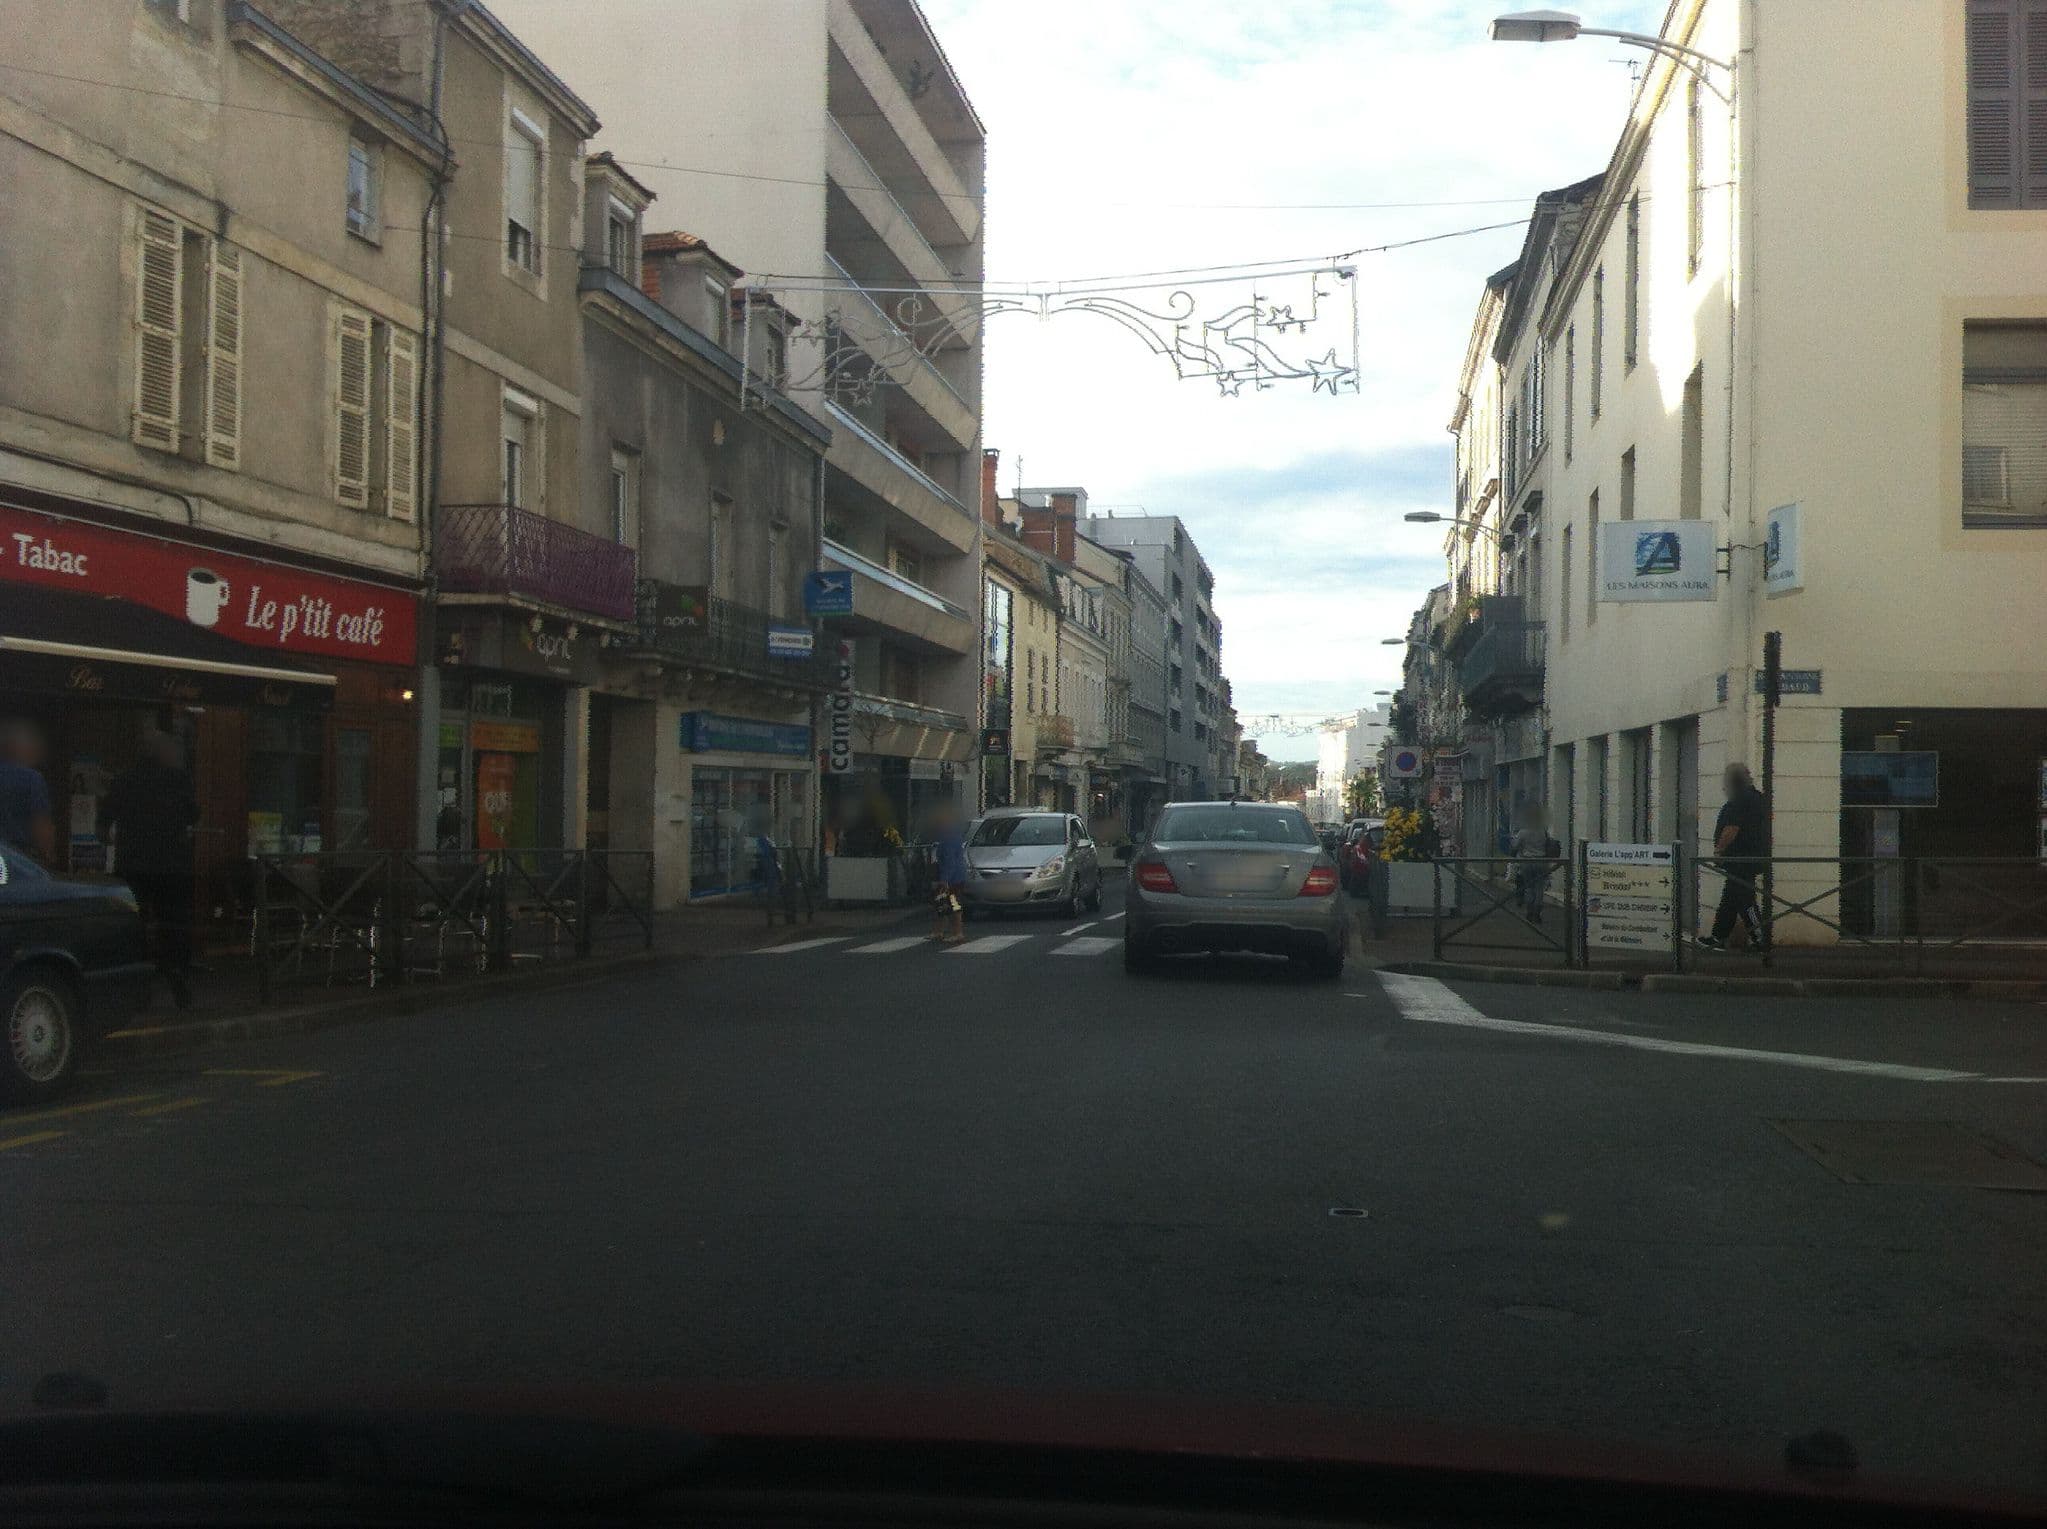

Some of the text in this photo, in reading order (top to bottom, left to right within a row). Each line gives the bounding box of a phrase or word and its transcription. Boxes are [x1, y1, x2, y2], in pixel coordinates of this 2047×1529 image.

[12, 532, 88, 576] Tabac
[1606, 582, 1627, 591] LES
[1628, 580, 1679, 591] MAISONS
[245, 585, 385, 646] Le p'tit café
[1589, 849, 1613, 858] Galerie
